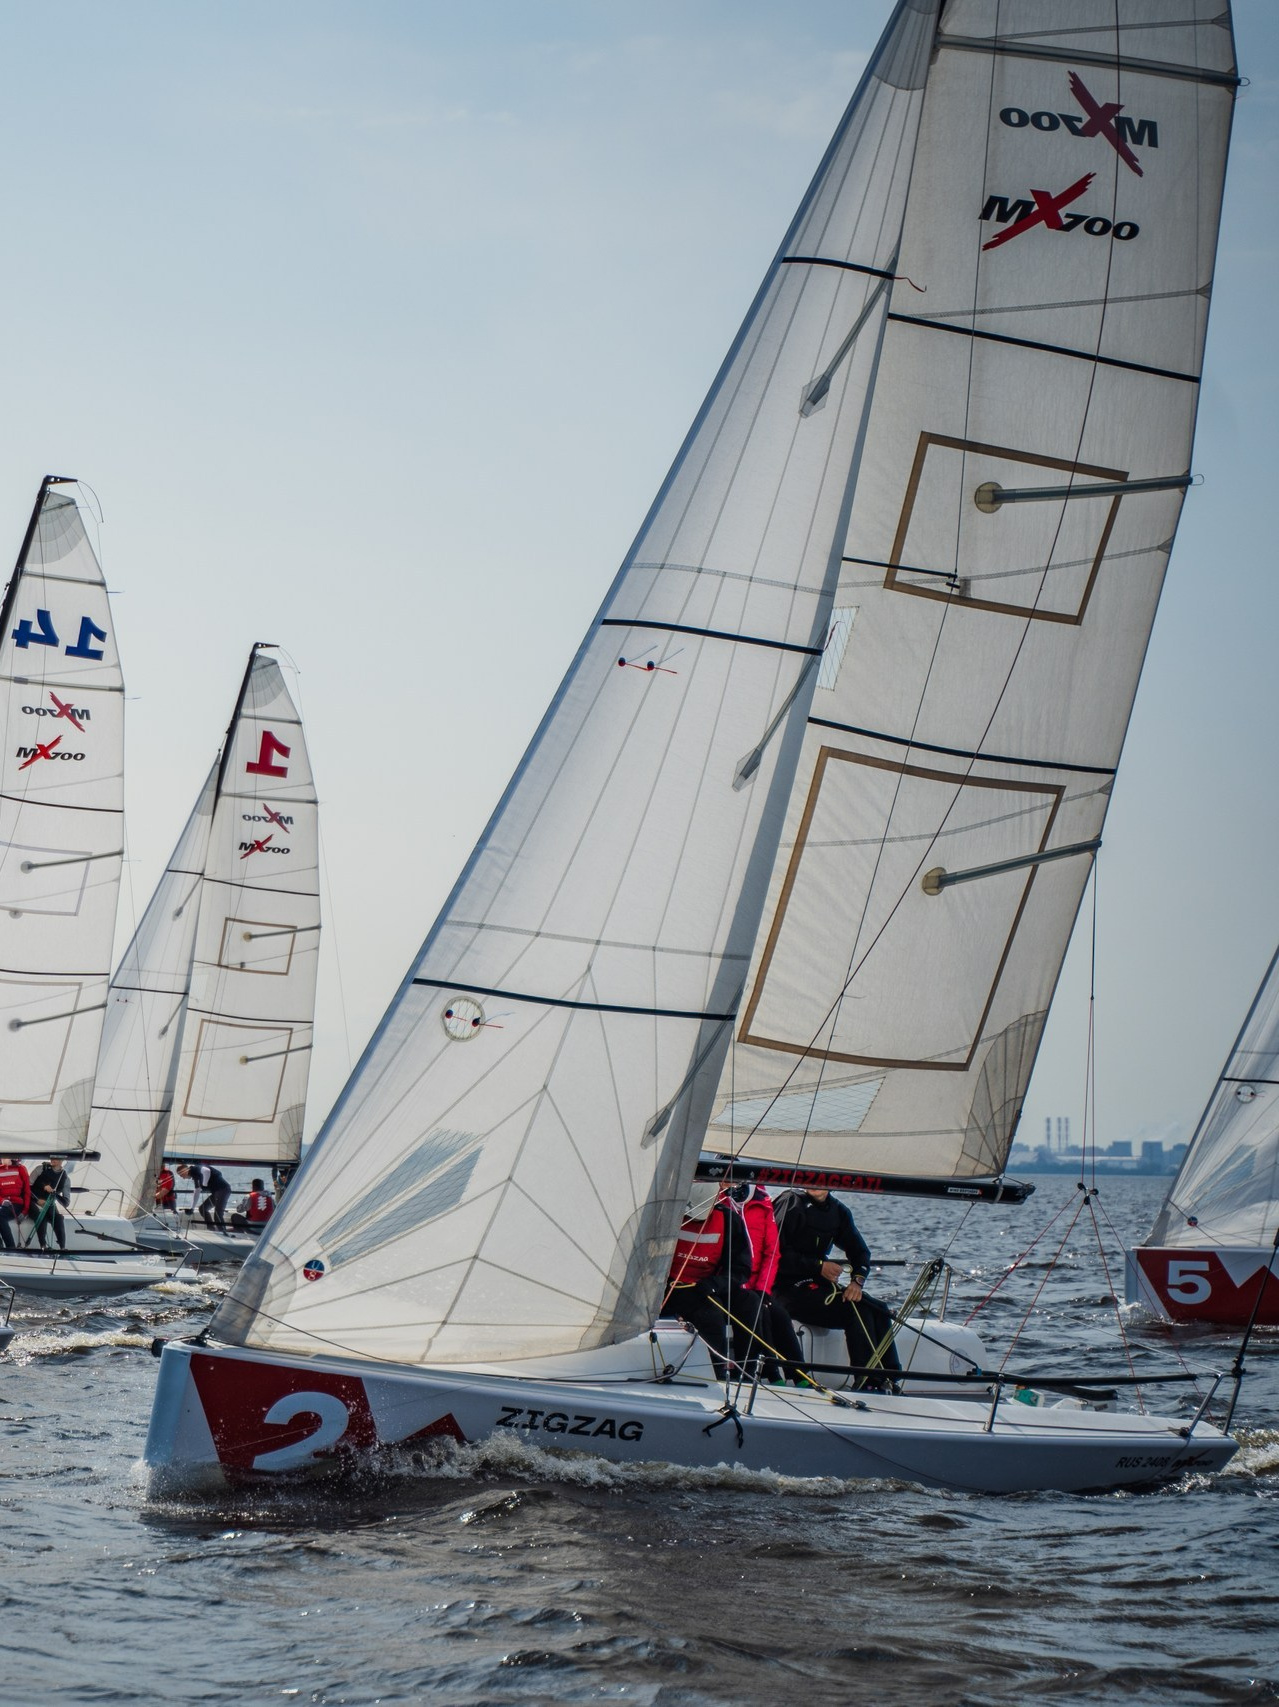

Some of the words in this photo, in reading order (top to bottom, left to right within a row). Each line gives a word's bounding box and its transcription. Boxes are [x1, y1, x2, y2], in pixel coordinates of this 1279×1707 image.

[978, 171, 1140, 251] MX700
[16, 734, 86, 771] MX700
[238, 834, 290, 860] MX700
[1167, 1260, 1212, 1305] 5
[251, 1390, 350, 1472] 2
[495, 1405, 645, 1442] ZIGZAG
[1115, 1456, 1143, 1468] RUS
